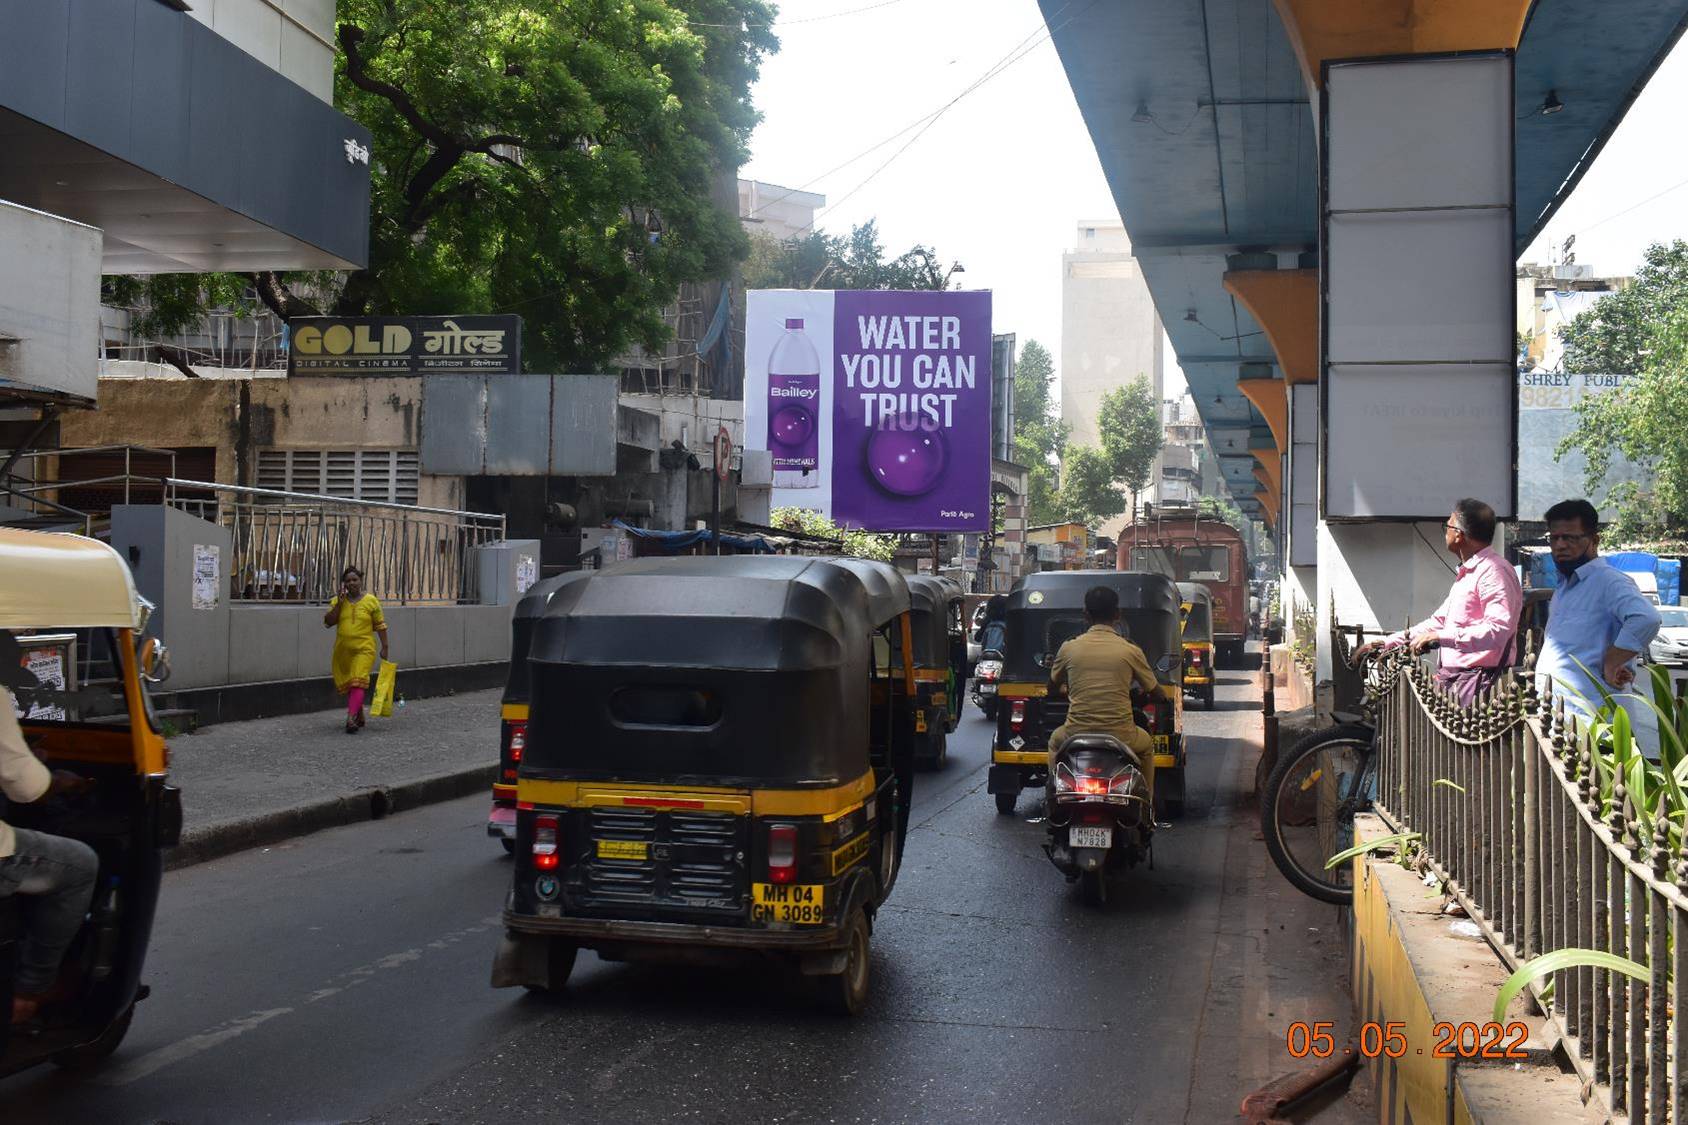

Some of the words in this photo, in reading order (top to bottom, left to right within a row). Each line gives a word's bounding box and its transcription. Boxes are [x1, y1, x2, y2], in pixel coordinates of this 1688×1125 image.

[294, 324, 413, 355] GOLD
[423, 320, 506, 355] गोल्ड
[857, 315, 961, 350] WATER
[840, 354, 901, 389] YOU
[912, 354, 976, 389] CAN
[1523, 374, 1572, 387] SHREY
[770, 386, 817, 400] Bailley
[860, 393, 958, 432] TRUST
[763, 885, 788, 902] MH
[793, 886, 813, 903] 04
[753, 903, 775, 921] GN
[782, 905, 822, 922] 3089
